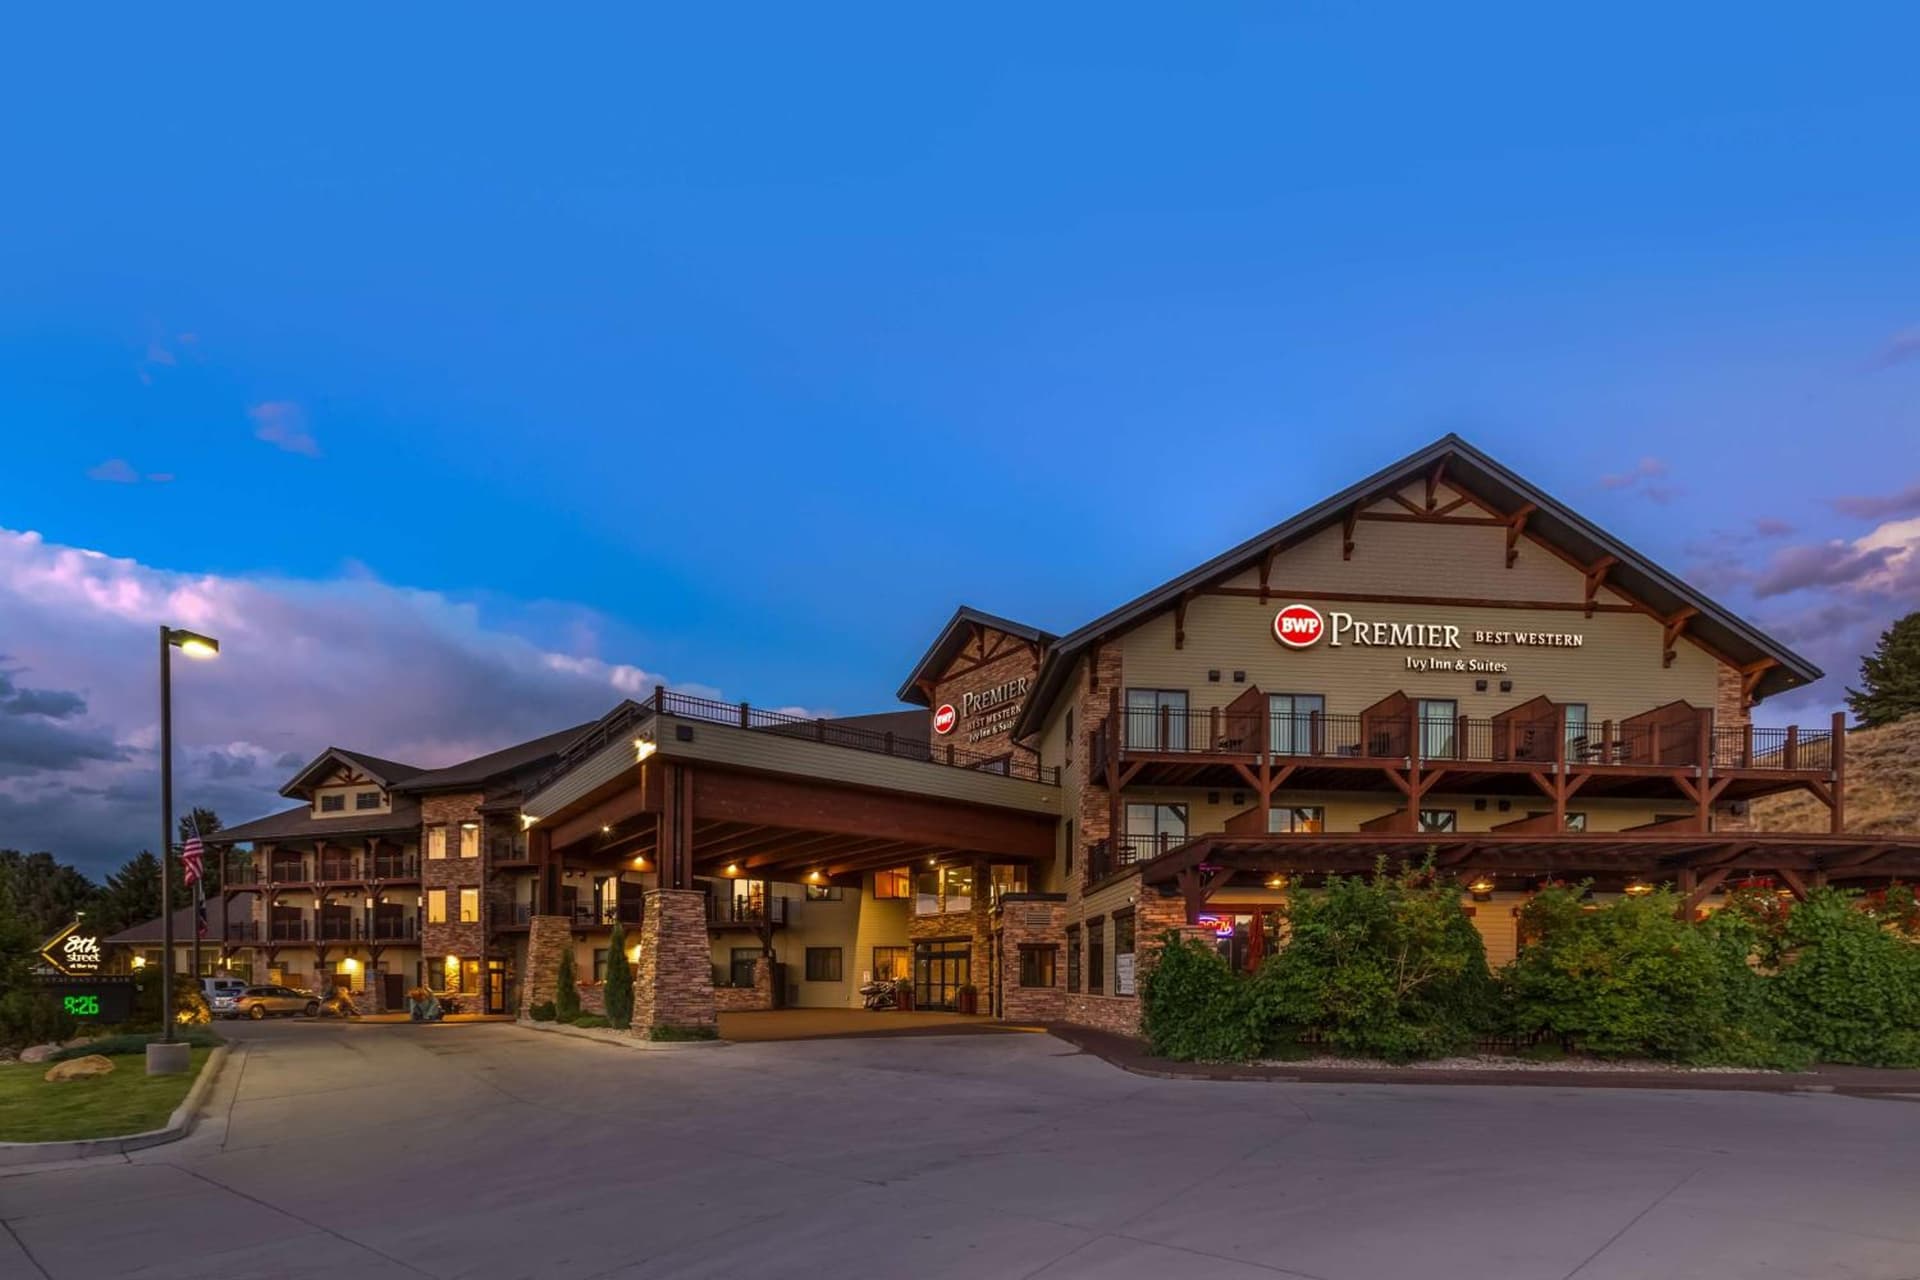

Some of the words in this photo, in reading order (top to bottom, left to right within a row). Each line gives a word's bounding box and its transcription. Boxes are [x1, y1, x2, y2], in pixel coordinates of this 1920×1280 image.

[1281, 617, 1319, 634] BWP
[1329, 612, 1461, 649] PREMIER
[1474, 630, 1511, 645] BEST
[1515, 632, 1584, 647] WESTERN
[1406, 656, 1428, 672] Ivy
[1430, 657, 1452, 671] Inn
[1455, 659, 1466, 671] &
[1469, 659, 1508, 672] Suites
[962, 677, 1027, 718] PREMIER
[999, 719, 1016, 732] Suite
[64, 935, 100, 953] 8th
[66, 952, 101, 962] street
[64, 996, 99, 1015] 8:26
